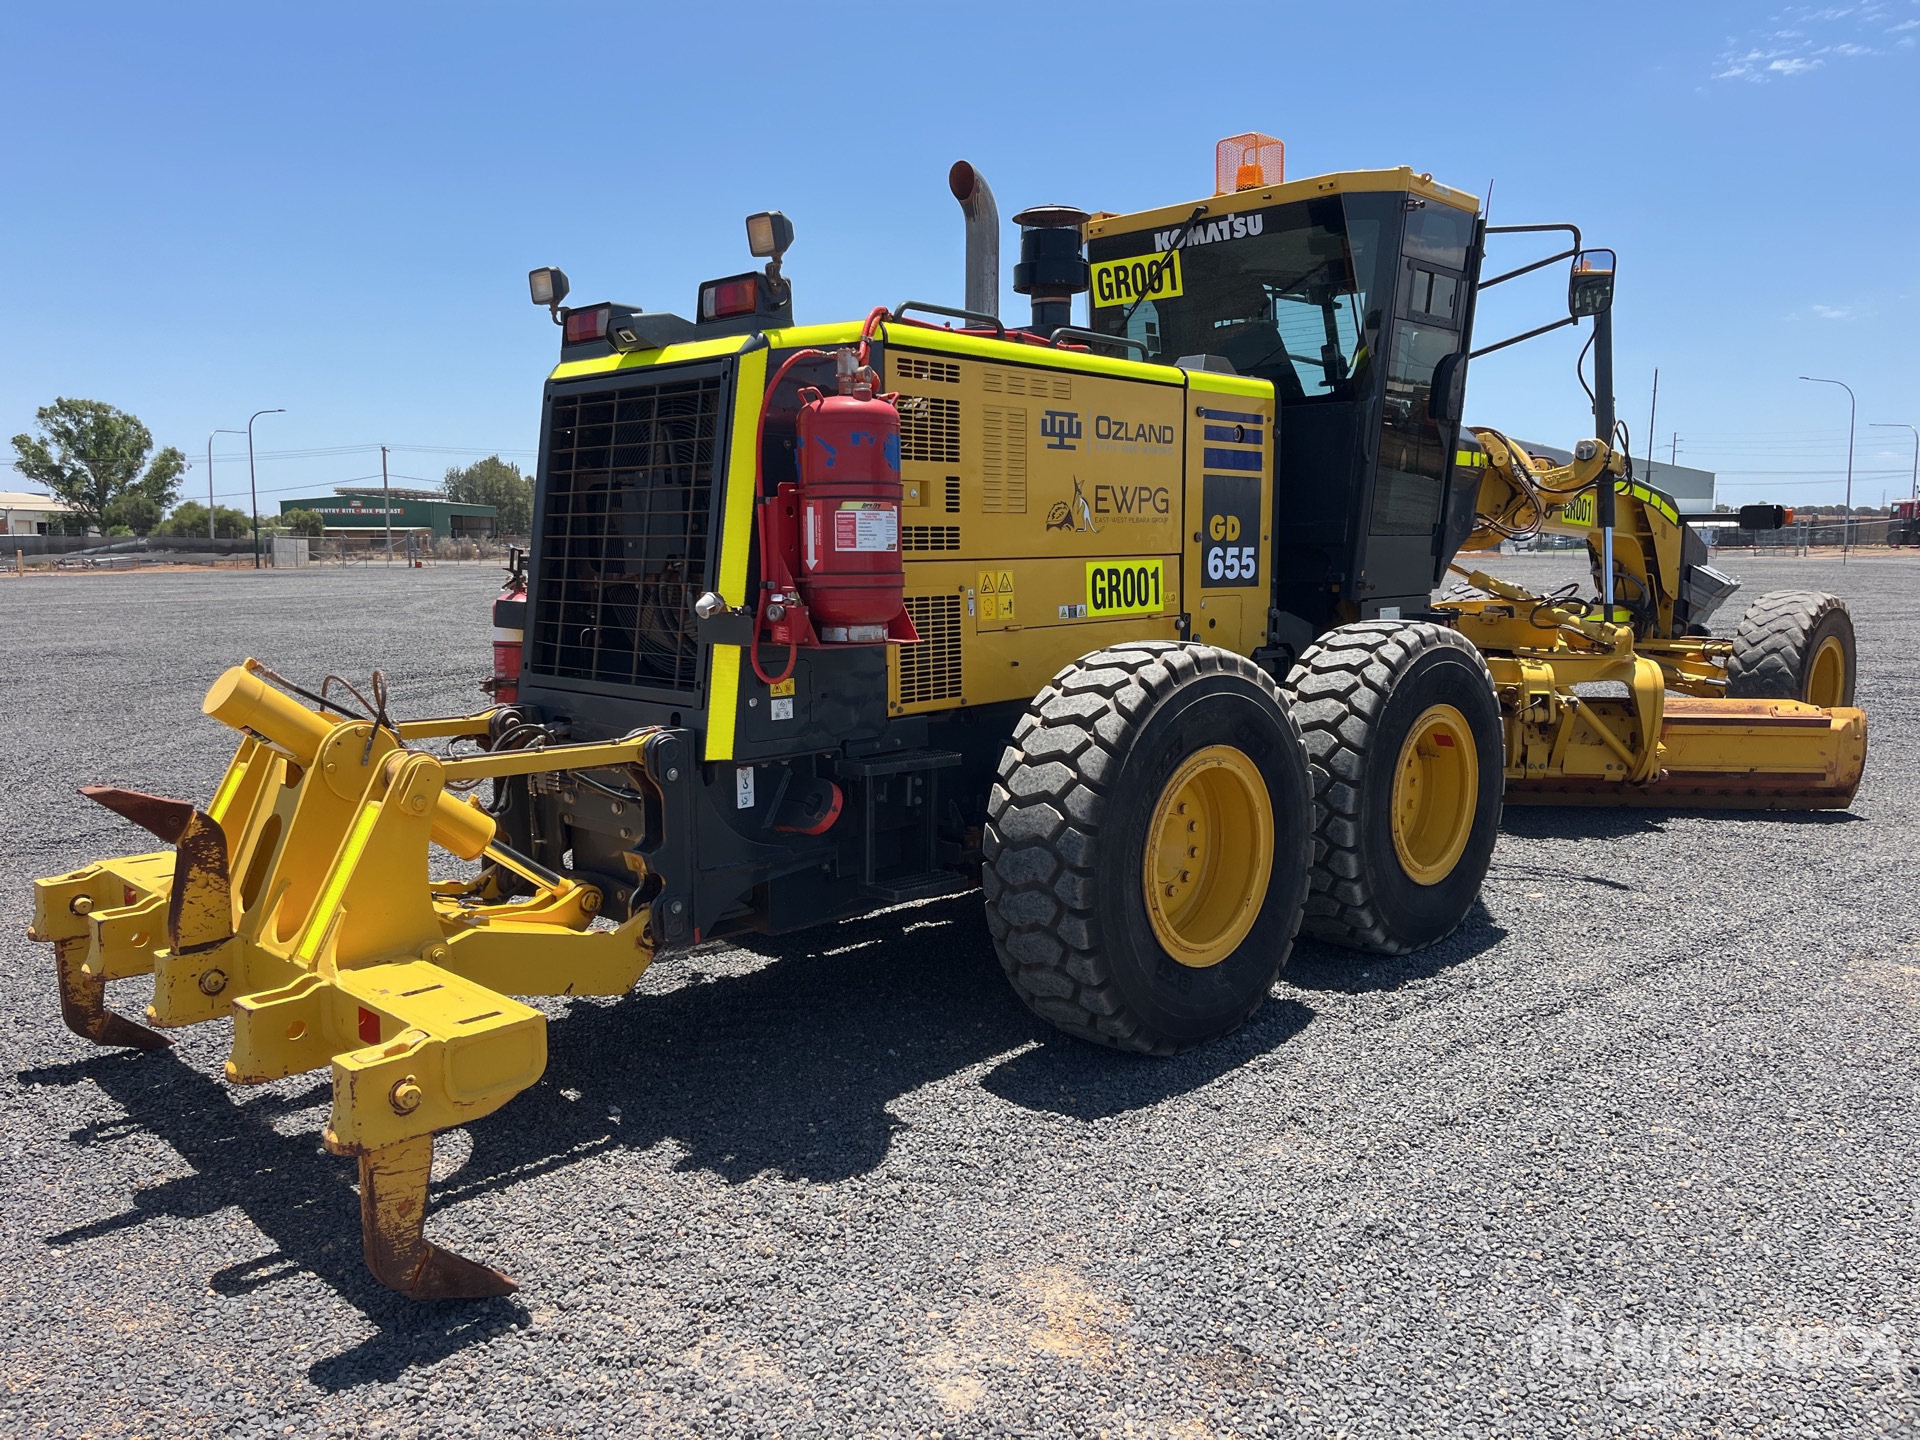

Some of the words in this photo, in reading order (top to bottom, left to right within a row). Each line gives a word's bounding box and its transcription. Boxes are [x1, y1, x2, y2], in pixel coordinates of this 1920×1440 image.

[1153, 213, 1263, 252] KOMATSU
[1097, 257, 1178, 302] GR001
[1095, 415, 1174, 445] OZLAND
[1094, 485, 1170, 514] EWPG
[1209, 514, 1241, 542] GD
[1207, 546, 1256, 580] 655
[1091, 566, 1160, 611] GR001
